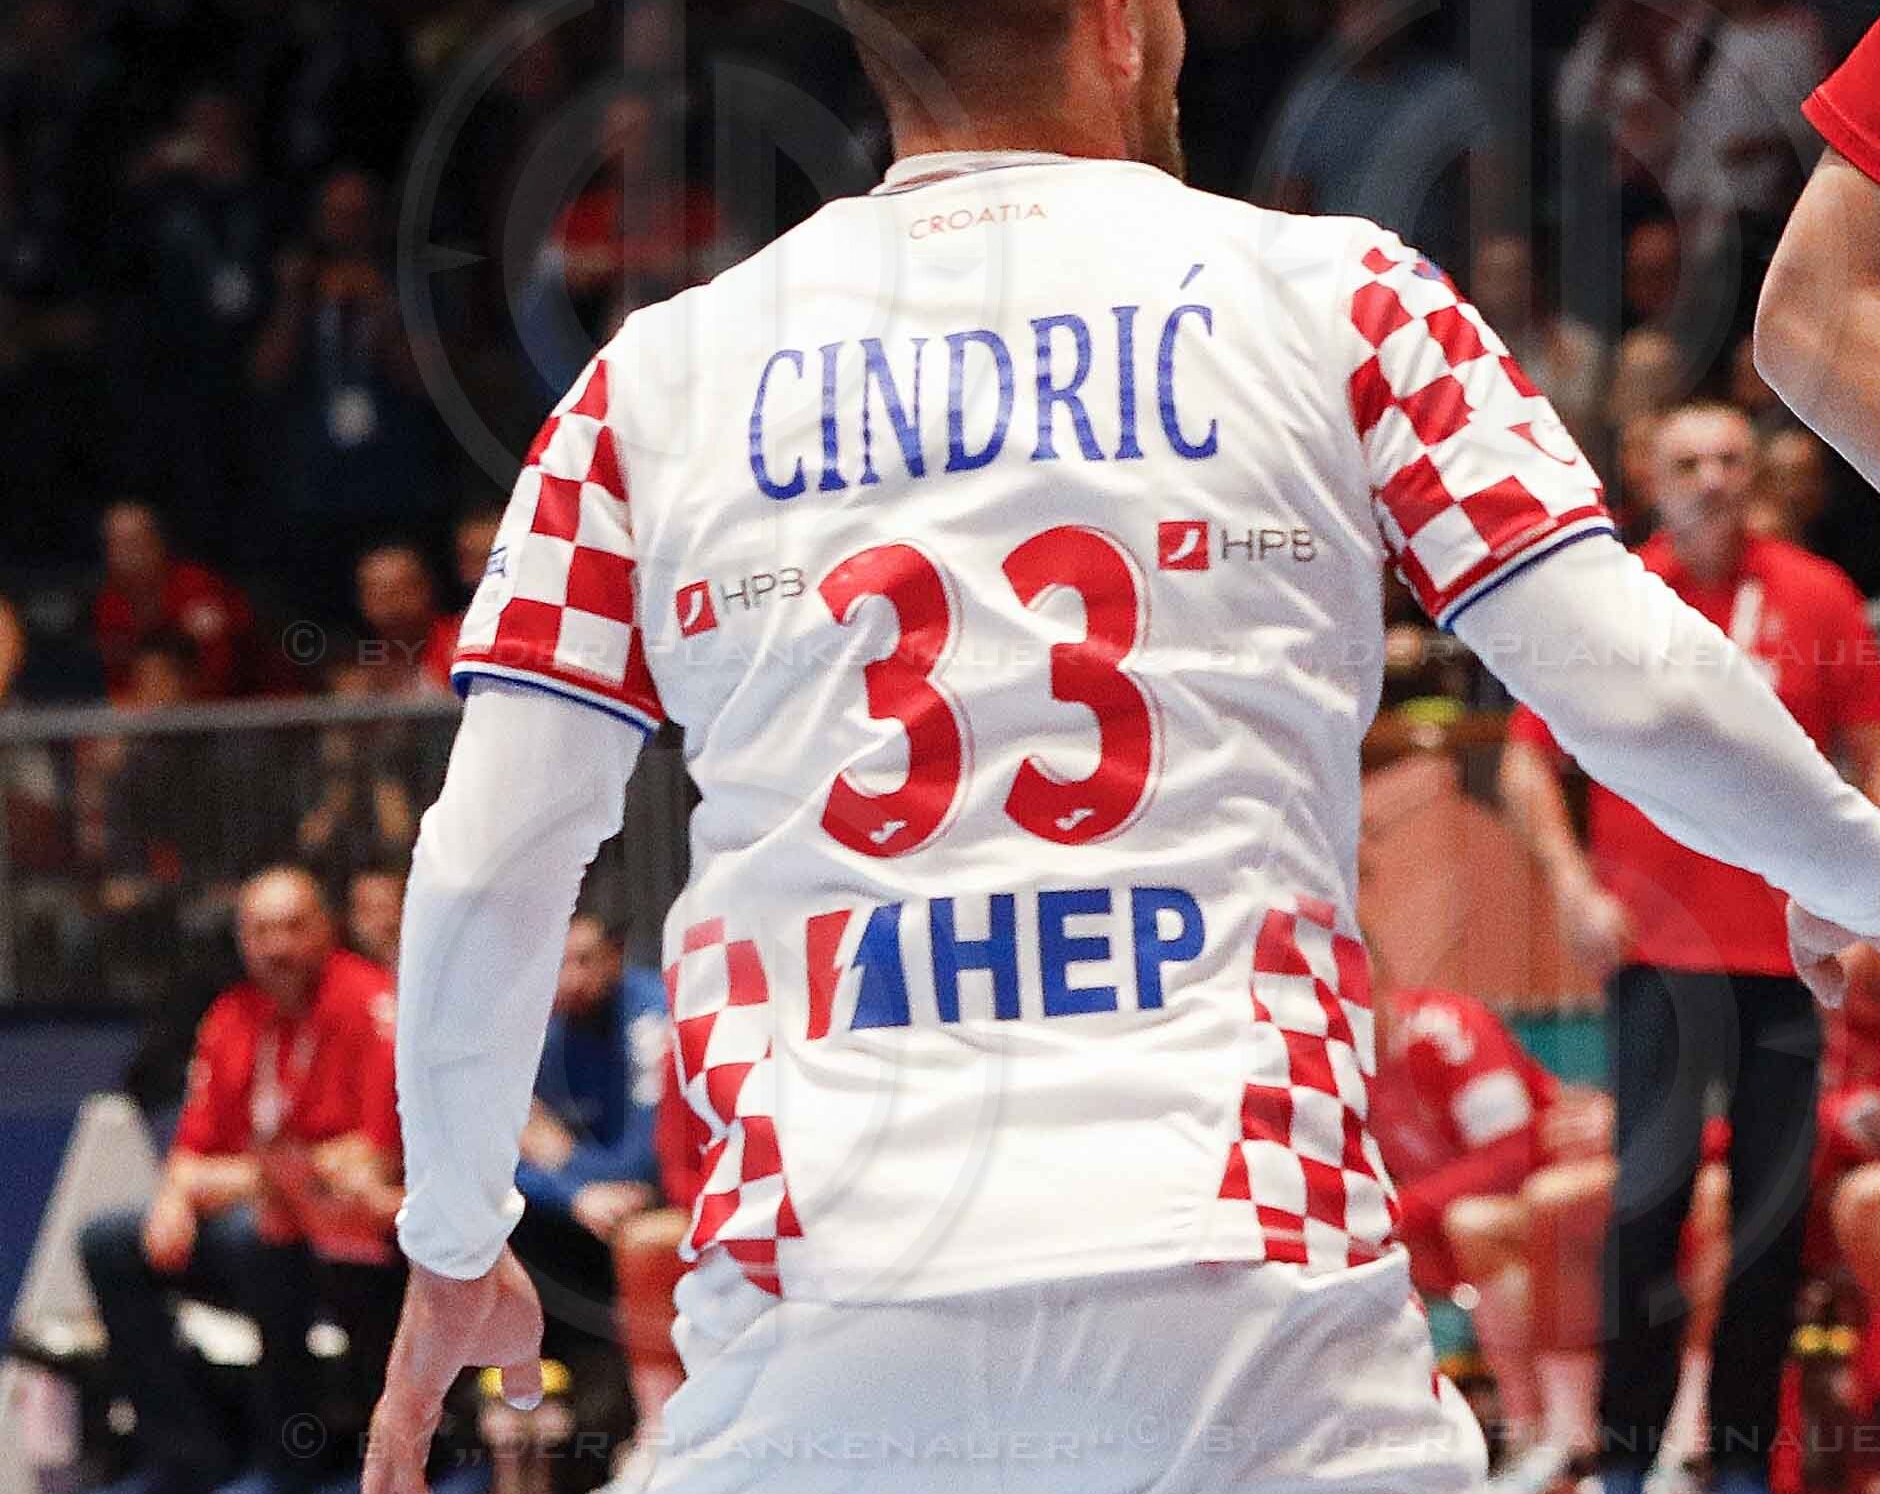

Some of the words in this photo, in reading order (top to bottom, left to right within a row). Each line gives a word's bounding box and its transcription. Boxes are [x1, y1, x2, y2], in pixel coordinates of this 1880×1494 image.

[909, 202, 1047, 241] CROATIA
[747, 263, 1219, 502] CINDRIĆ
[1220, 525, 1319, 564] HPB
[818, 524, 1158, 859] 33
[928, 887, 1206, 1024] HEP
